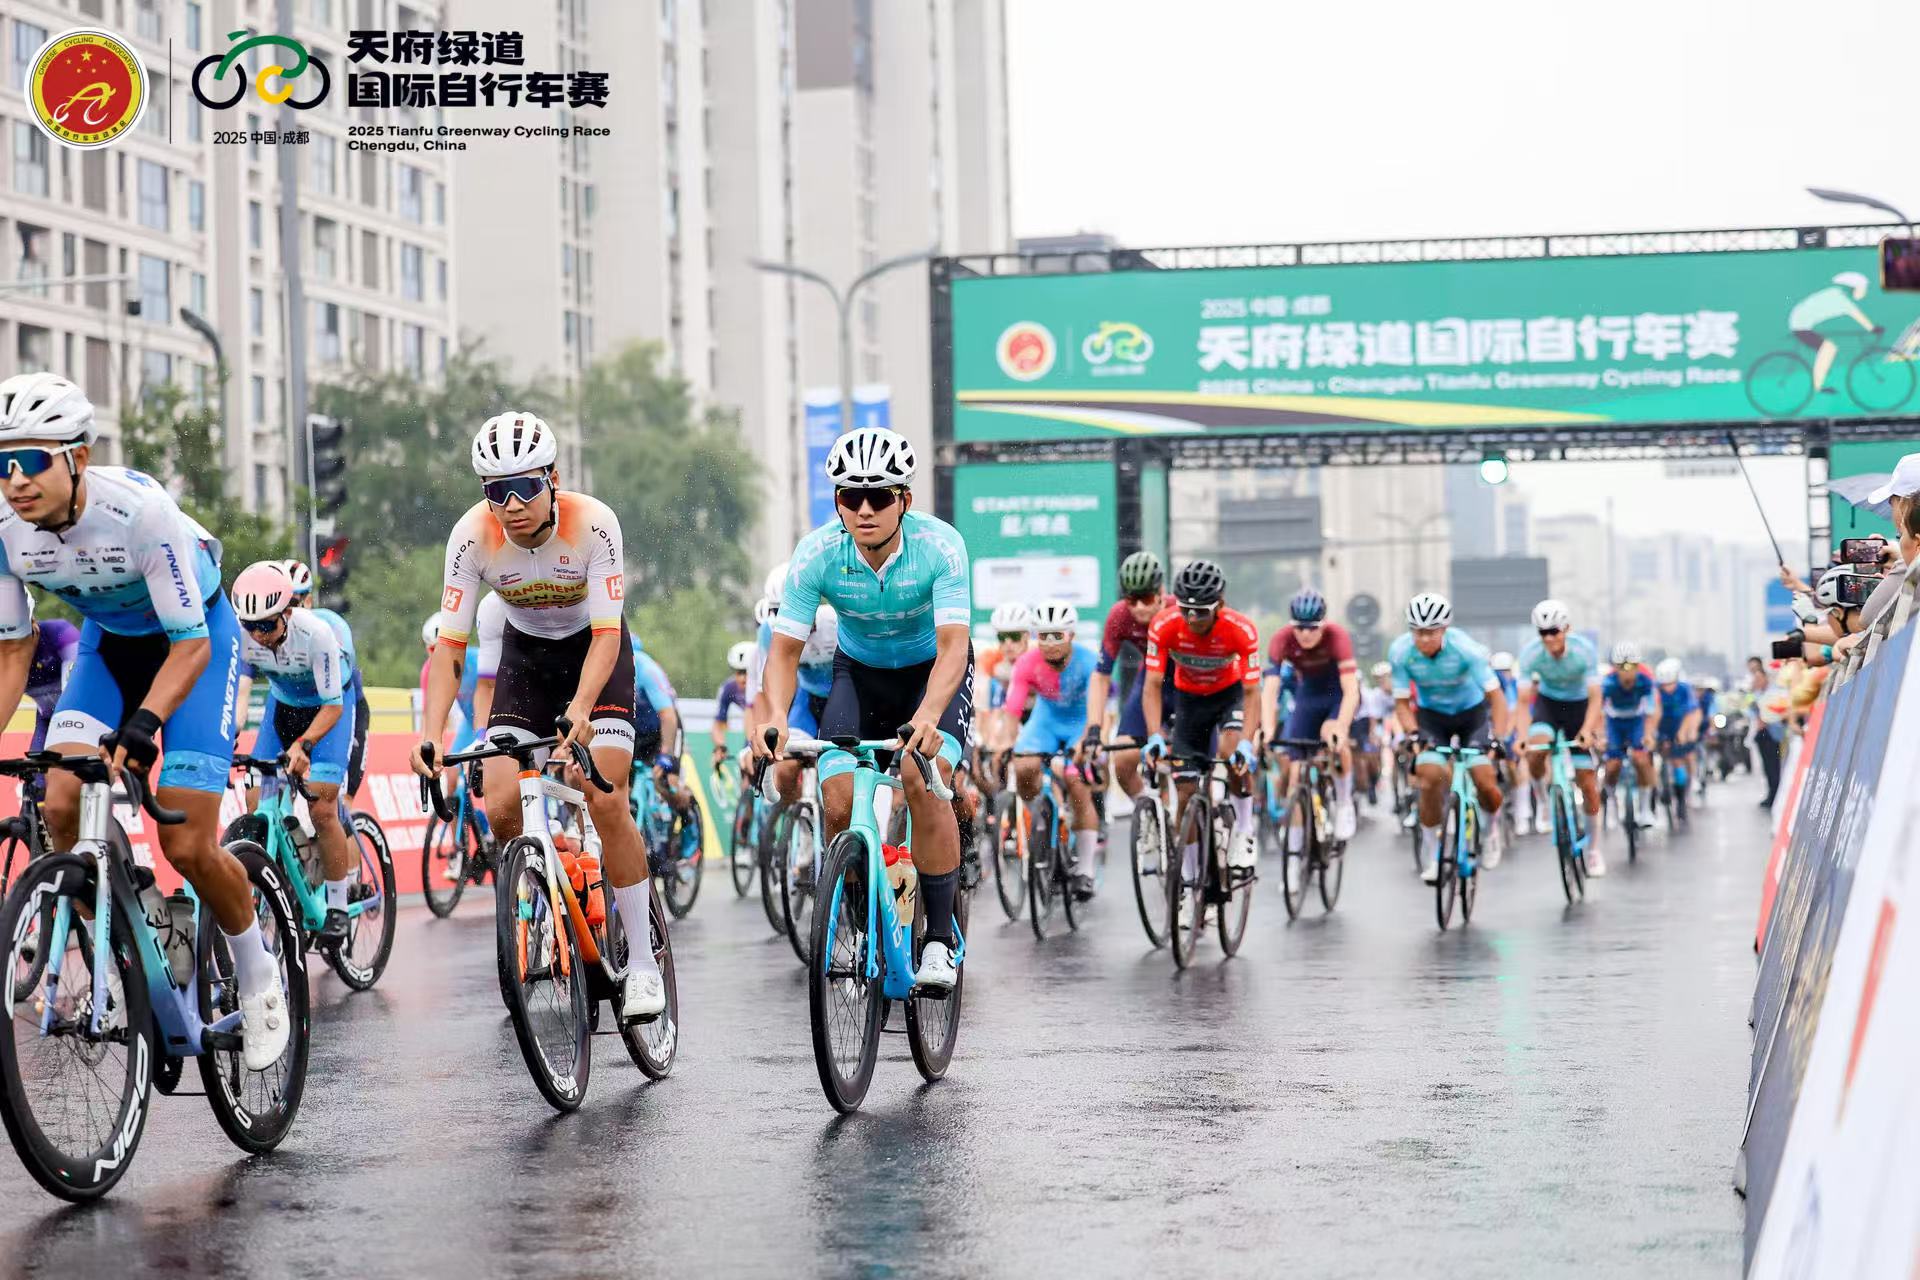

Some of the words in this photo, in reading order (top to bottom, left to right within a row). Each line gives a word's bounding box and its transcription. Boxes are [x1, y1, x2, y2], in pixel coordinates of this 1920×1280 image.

[1198, 311, 1740, 372] 天府绿道国际自行车赛
[1602, 367, 1682, 388] Cycling
[161, 543, 192, 608] PINGTAN
[219, 636, 240, 742] PINGTAN
[56, 720, 85, 729] MBO
